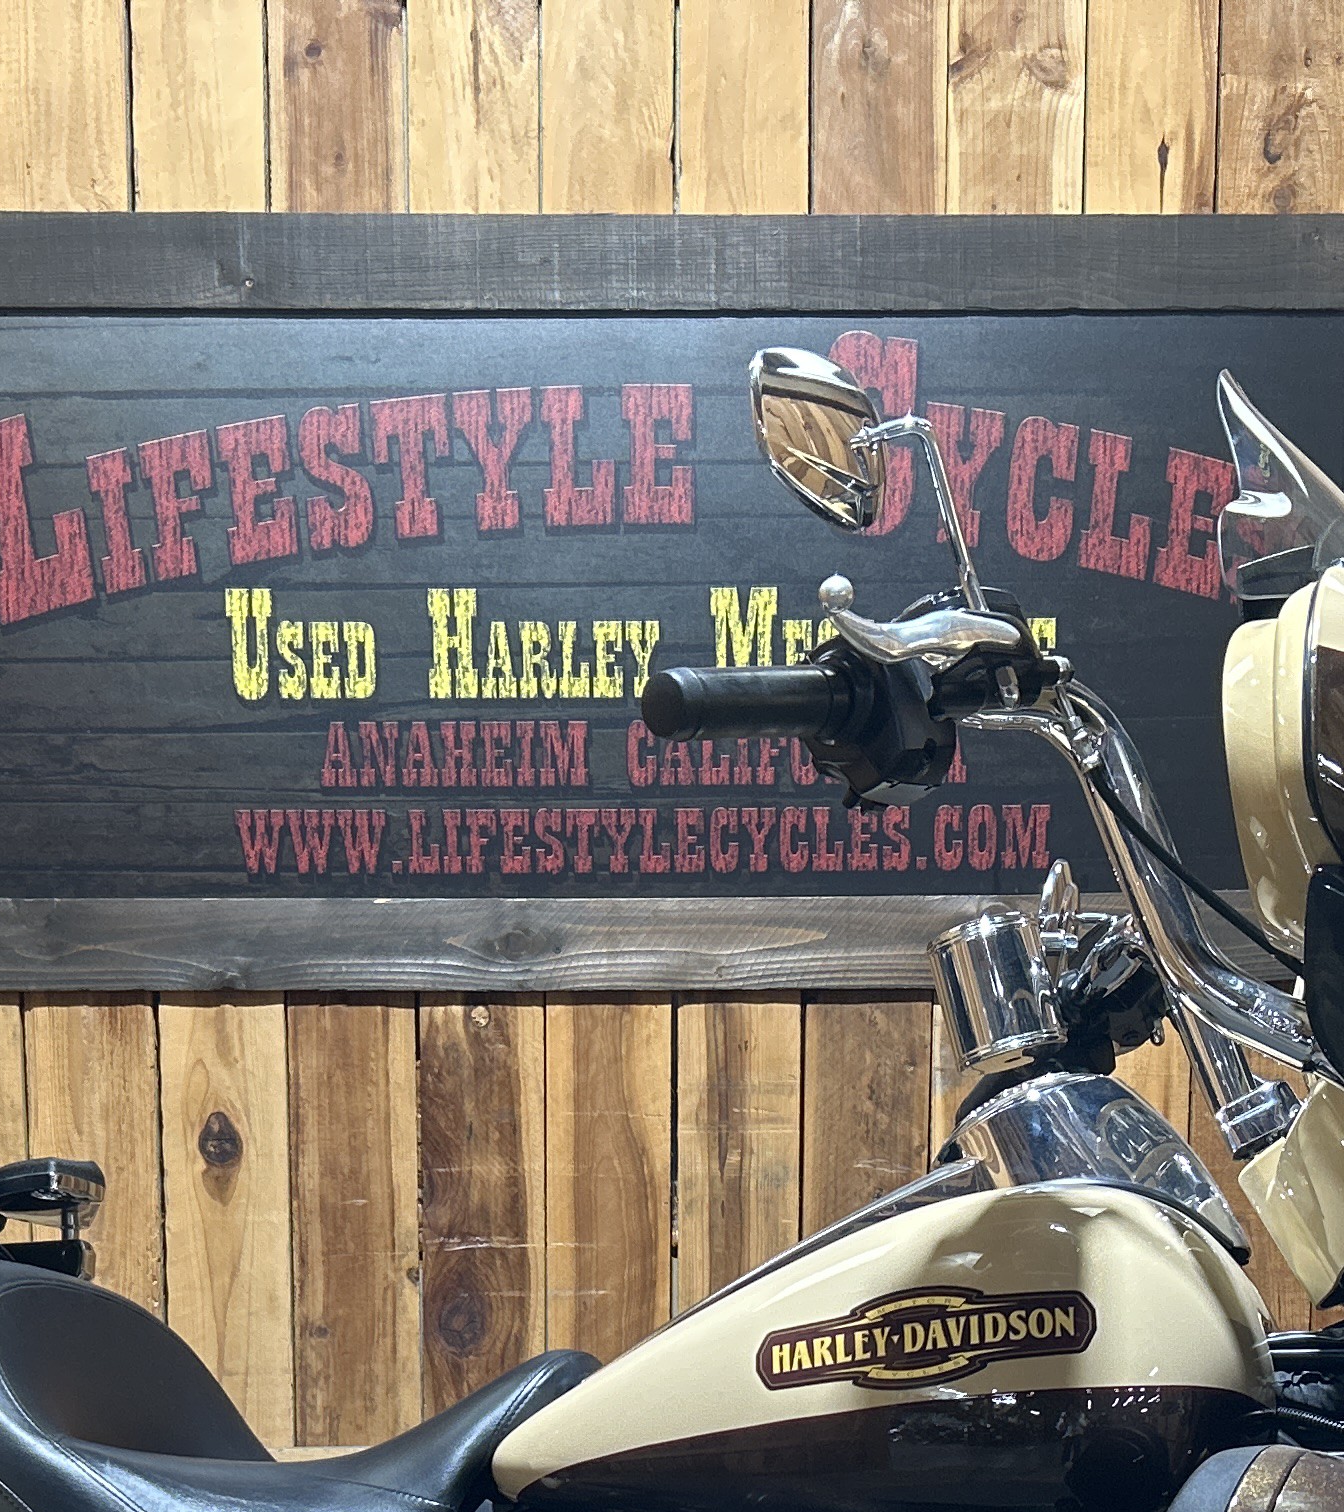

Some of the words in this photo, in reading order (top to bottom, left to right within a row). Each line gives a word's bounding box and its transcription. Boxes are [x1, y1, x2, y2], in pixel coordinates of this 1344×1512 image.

[224, 588, 377, 700] USED
[426, 588, 660, 700] HARLEY
[320, 720, 589, 788] ANAHEIM
[626, 719, 968, 787] CALIFO
[234, 804, 1052, 875] WWW.LIFESTYLECYCLES.COM
